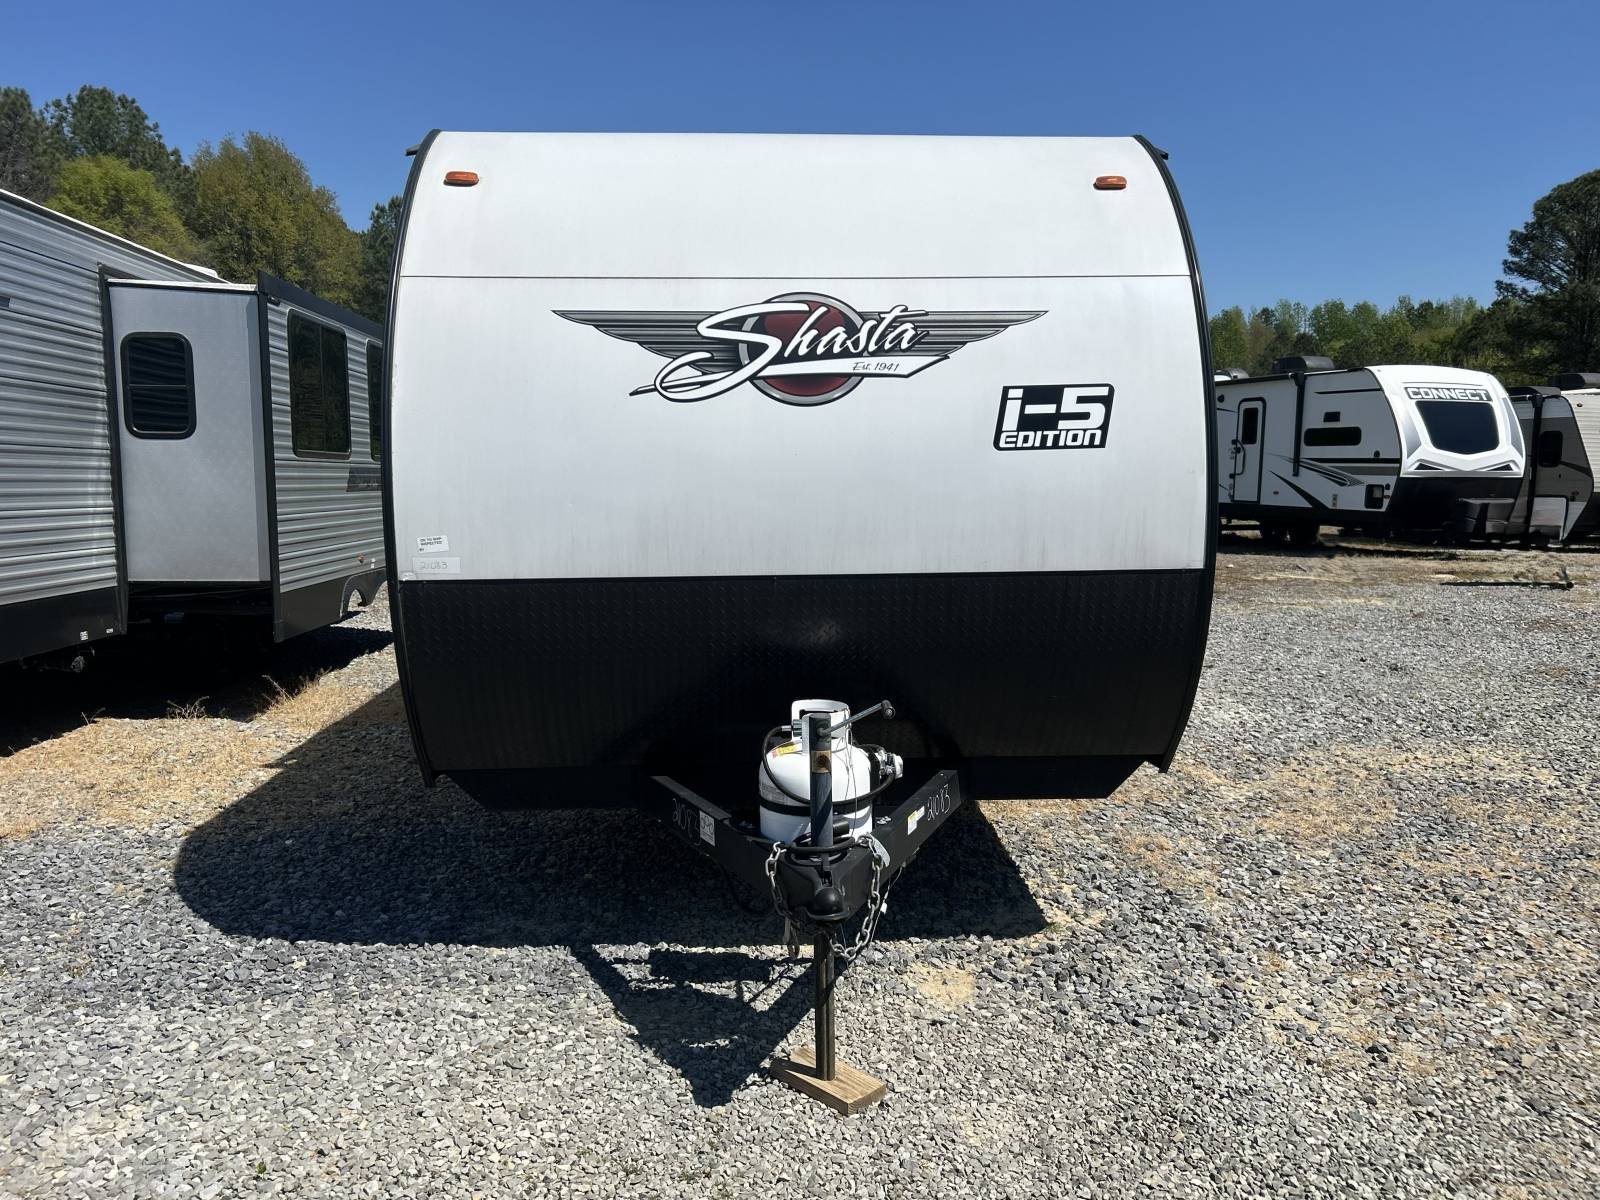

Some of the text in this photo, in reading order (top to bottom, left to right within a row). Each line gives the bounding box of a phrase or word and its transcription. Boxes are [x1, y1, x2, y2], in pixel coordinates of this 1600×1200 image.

[653, 301, 930, 403] Shasta
[874, 362, 900, 371] 1941
[1406, 387, 1488, 401] CONNECT
[1001, 386, 1110, 431] i-5
[999, 429, 1102, 448] EDITION
[927, 783, 951, 821] 21083
